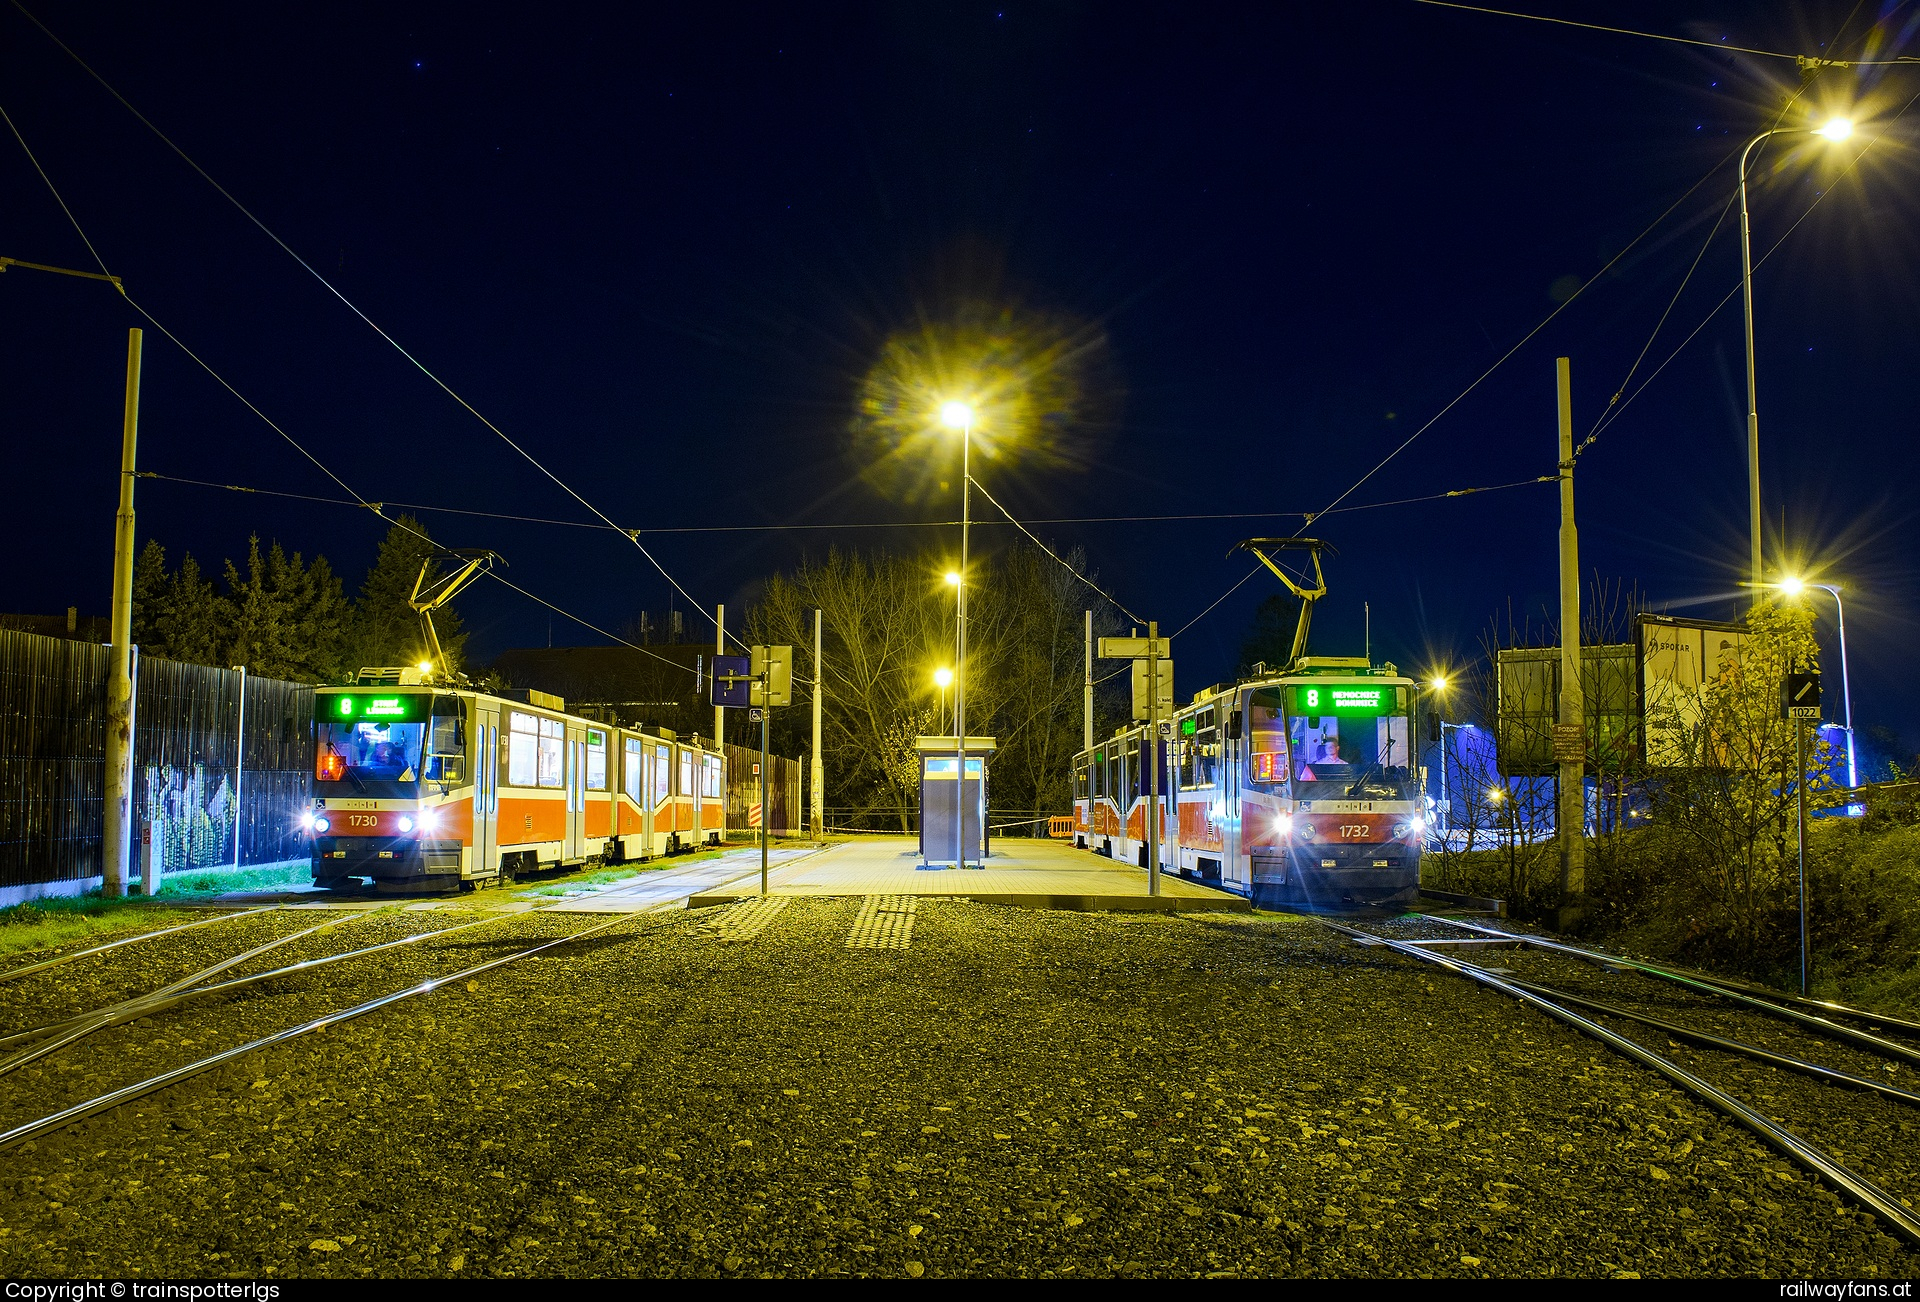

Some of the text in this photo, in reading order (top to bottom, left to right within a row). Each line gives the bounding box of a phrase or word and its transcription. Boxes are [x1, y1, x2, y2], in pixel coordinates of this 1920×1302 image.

[1660, 642, 1690, 653] SPOKAR
[1307, 689, 1319, 707] 8
[1332, 691, 1380, 699] NEMOCNICE
[340, 698, 352, 715] 8
[1792, 708, 1815, 717] 1022
[349, 815, 378, 827] 1730
[1339, 825, 1370, 838] 1732
